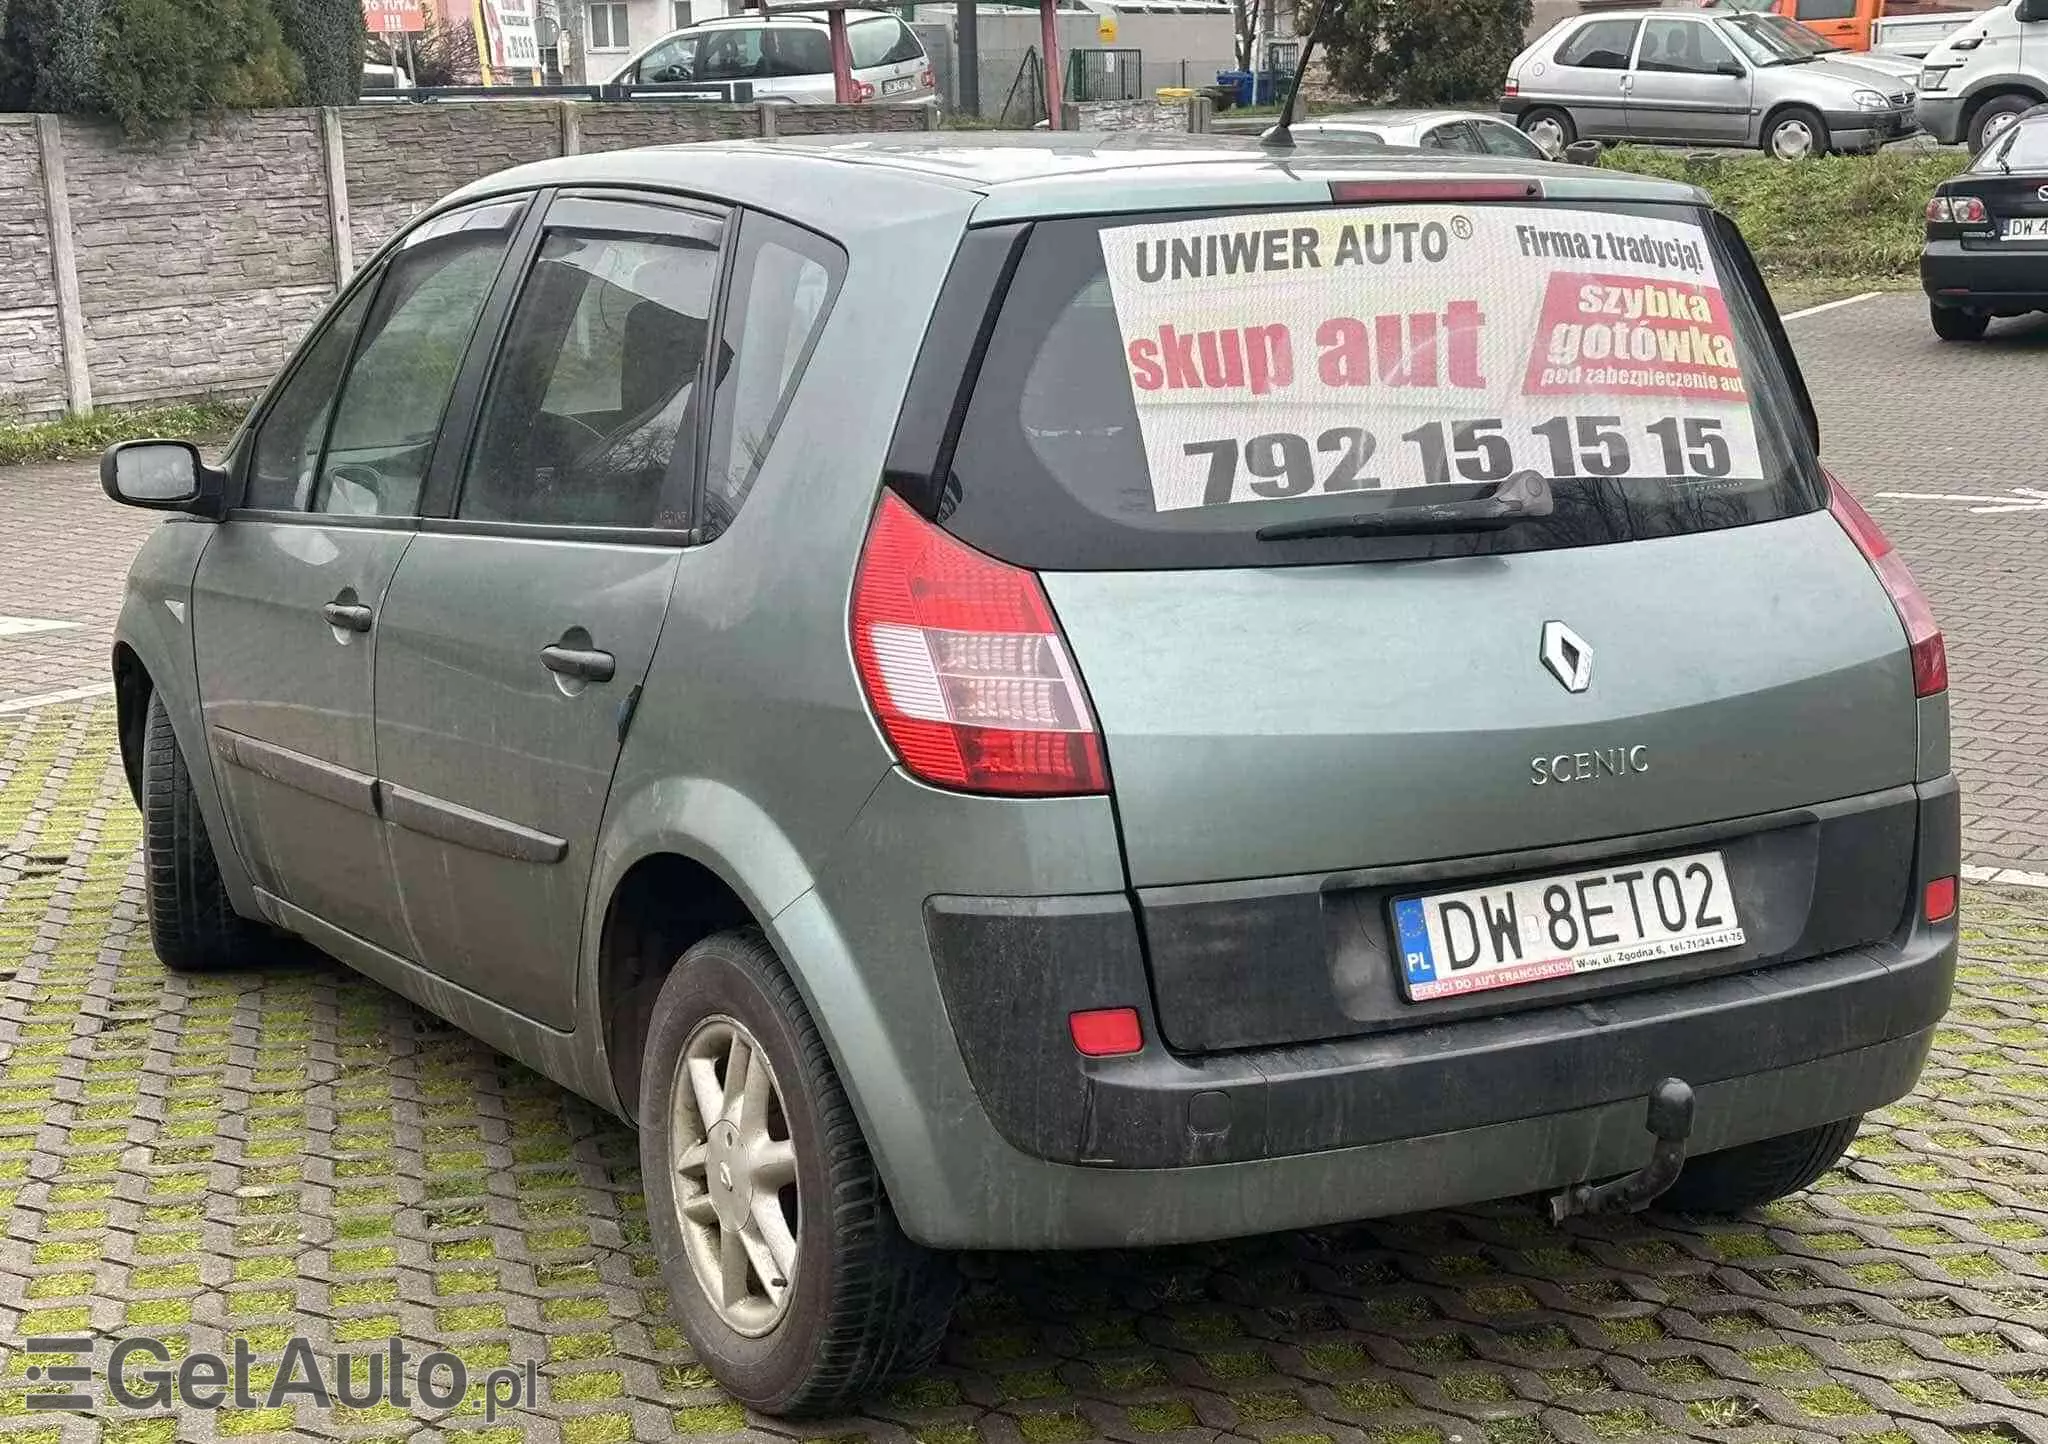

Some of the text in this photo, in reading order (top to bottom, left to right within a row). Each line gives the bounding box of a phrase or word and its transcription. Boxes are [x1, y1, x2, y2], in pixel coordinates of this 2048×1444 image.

[1516, 225, 1705, 275] Firma z tradycją!
[2012, 219, 2033, 236] DW
[1136, 225, 1322, 283] UNIWER
[1577, 284, 1713, 324] szybka
[1128, 300, 1487, 396] skup aut
[1547, 320, 1738, 369] gotówka
[1540, 366, 1582, 386] pod
[1585, 368, 1719, 391] zabezpieczenie
[1183, 415, 1733, 507] 792 15 15 15
[1530, 744, 1649, 786] SCENIC
[1438, 862, 1723, 971] DW 8ET02
[1407, 952, 1431, 971] PL
[1454, 978, 1473, 990] DO
[1475, 974, 1498, 988] AUT
[1498, 959, 1574, 983] FRANCUSKICH
[1617, 946, 1654, 962] Zgodna
